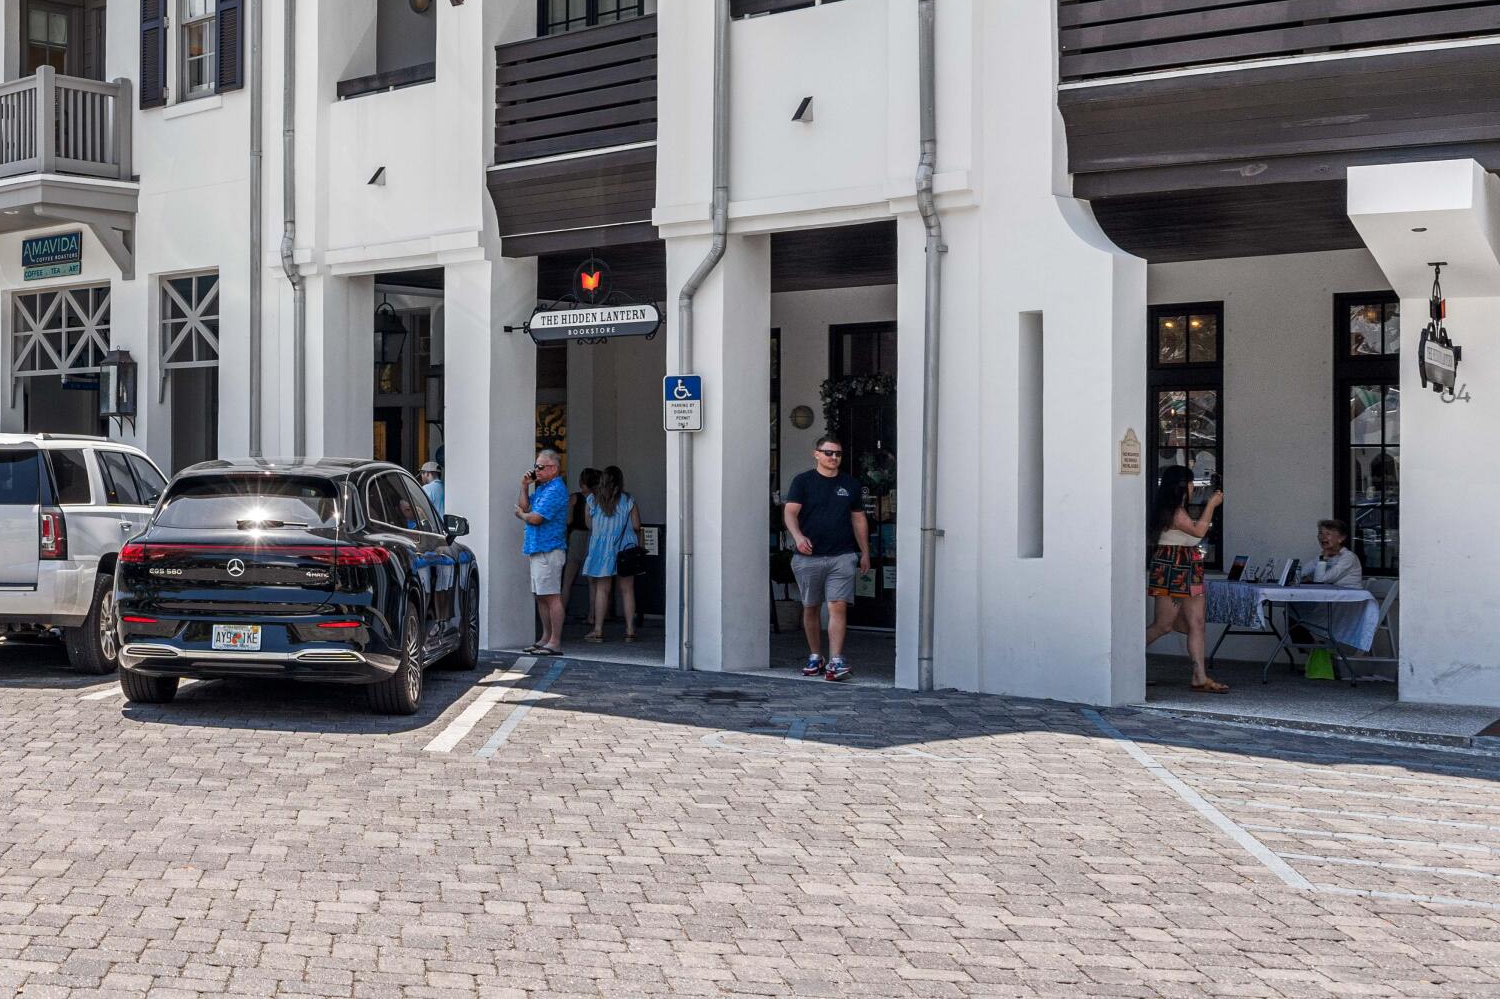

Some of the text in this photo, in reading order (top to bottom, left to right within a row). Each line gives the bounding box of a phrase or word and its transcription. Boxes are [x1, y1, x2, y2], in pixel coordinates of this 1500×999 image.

[24, 236, 78, 262] AMAVIDA
[36, 252, 78, 263] COFFEE ROASTERS
[25, 269, 43, 278] COFFEE
[68, 264, 79, 273] ART
[541, 308, 646, 326] THE HIDDEN LANTERN
[568, 326, 616, 336] BOOKSTORE
